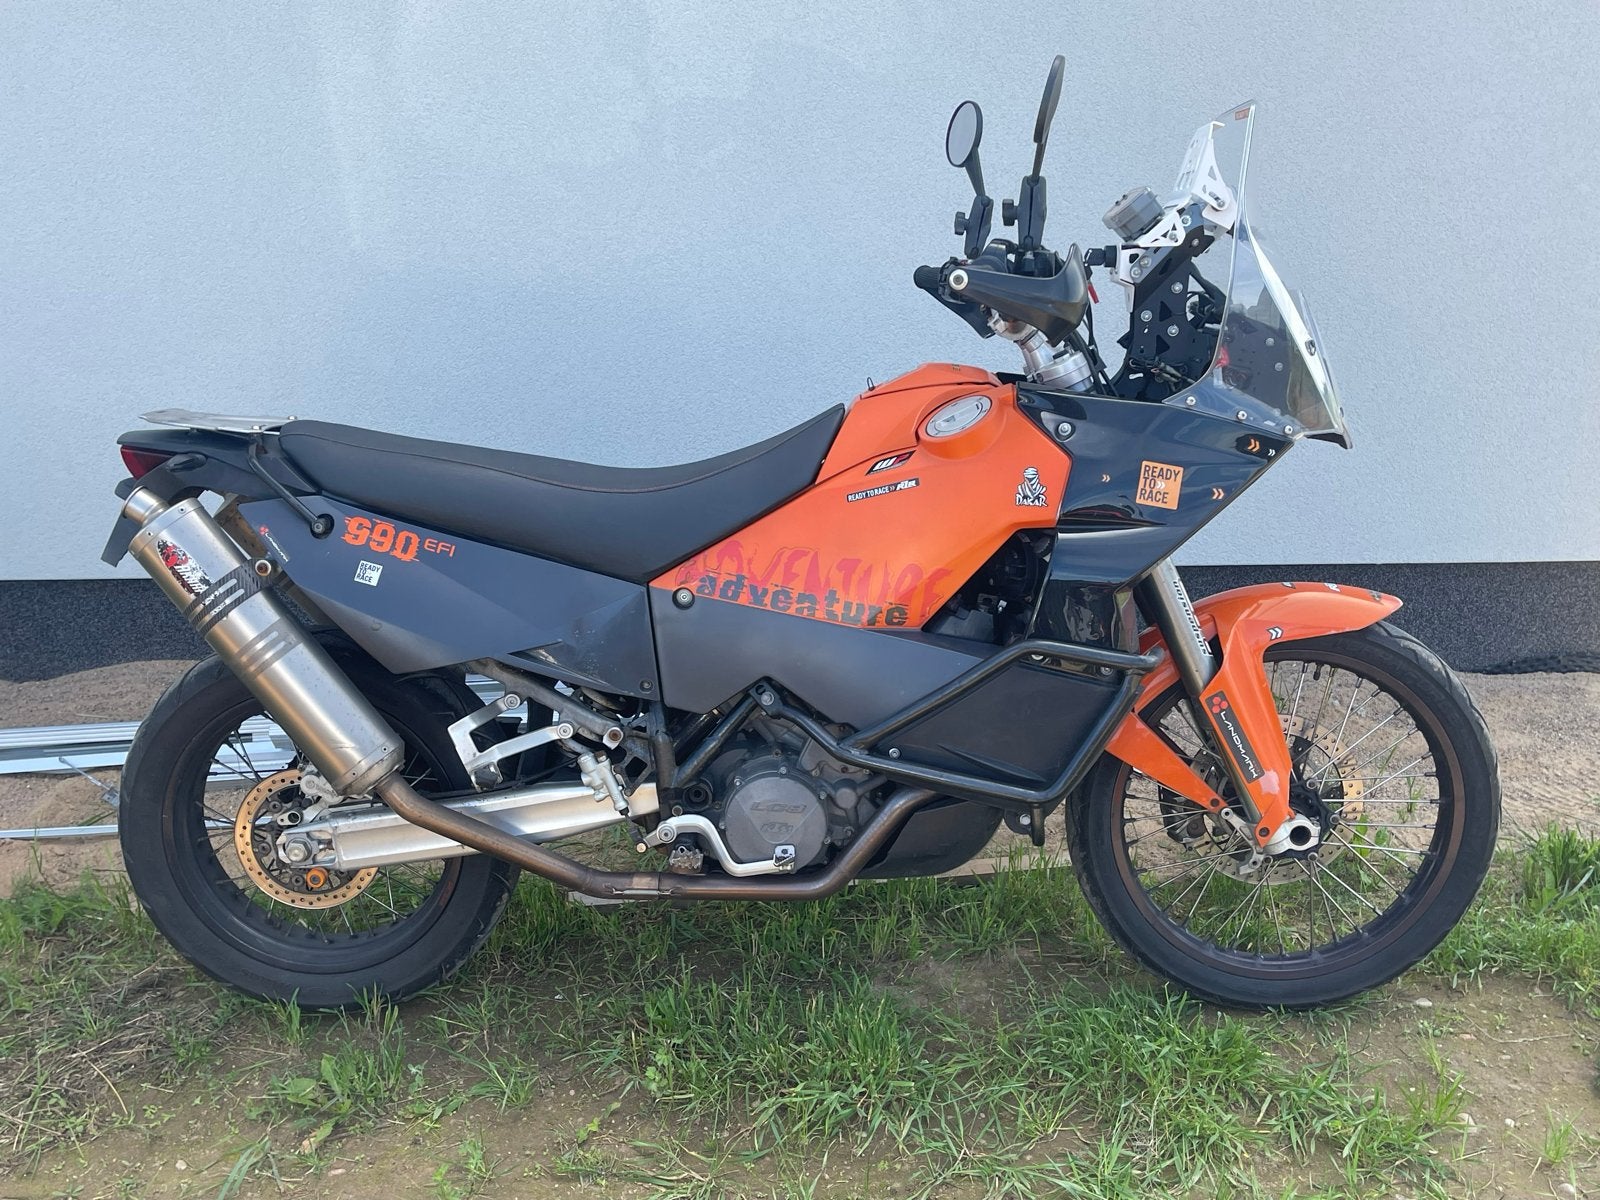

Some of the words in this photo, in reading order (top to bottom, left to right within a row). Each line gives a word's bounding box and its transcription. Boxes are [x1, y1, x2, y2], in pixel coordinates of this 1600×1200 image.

[1143, 464, 1180, 482] READY
[1142, 477, 1157, 488] TO
[848, 491, 867, 502] READY
[875, 486, 890, 496] RACE
[1015, 493, 1048, 507] DAKAR
[1139, 489, 1169, 504] RACE
[424, 538, 456, 557] EFI
[359, 563, 381, 573] READY
[356, 573, 373, 583] RACE
[696, 571, 909, 626] adventure
[1172, 579, 1213, 656] suspension
[1220, 710, 1259, 779] LANDMARK
